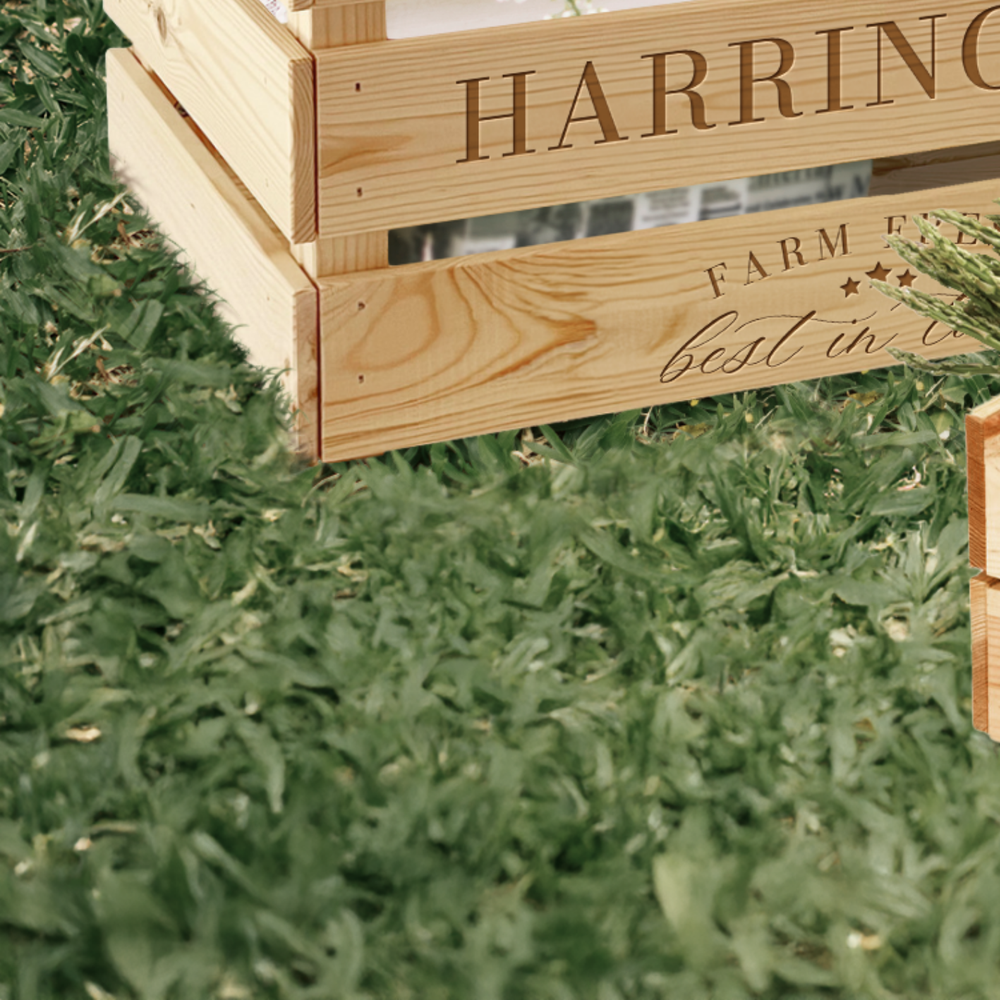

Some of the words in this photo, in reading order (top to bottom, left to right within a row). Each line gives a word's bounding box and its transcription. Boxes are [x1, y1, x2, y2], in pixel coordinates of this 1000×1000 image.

[703, 222, 853, 299] FARM
[659, 310, 876, 384] best
[826, 318, 899, 358] in
